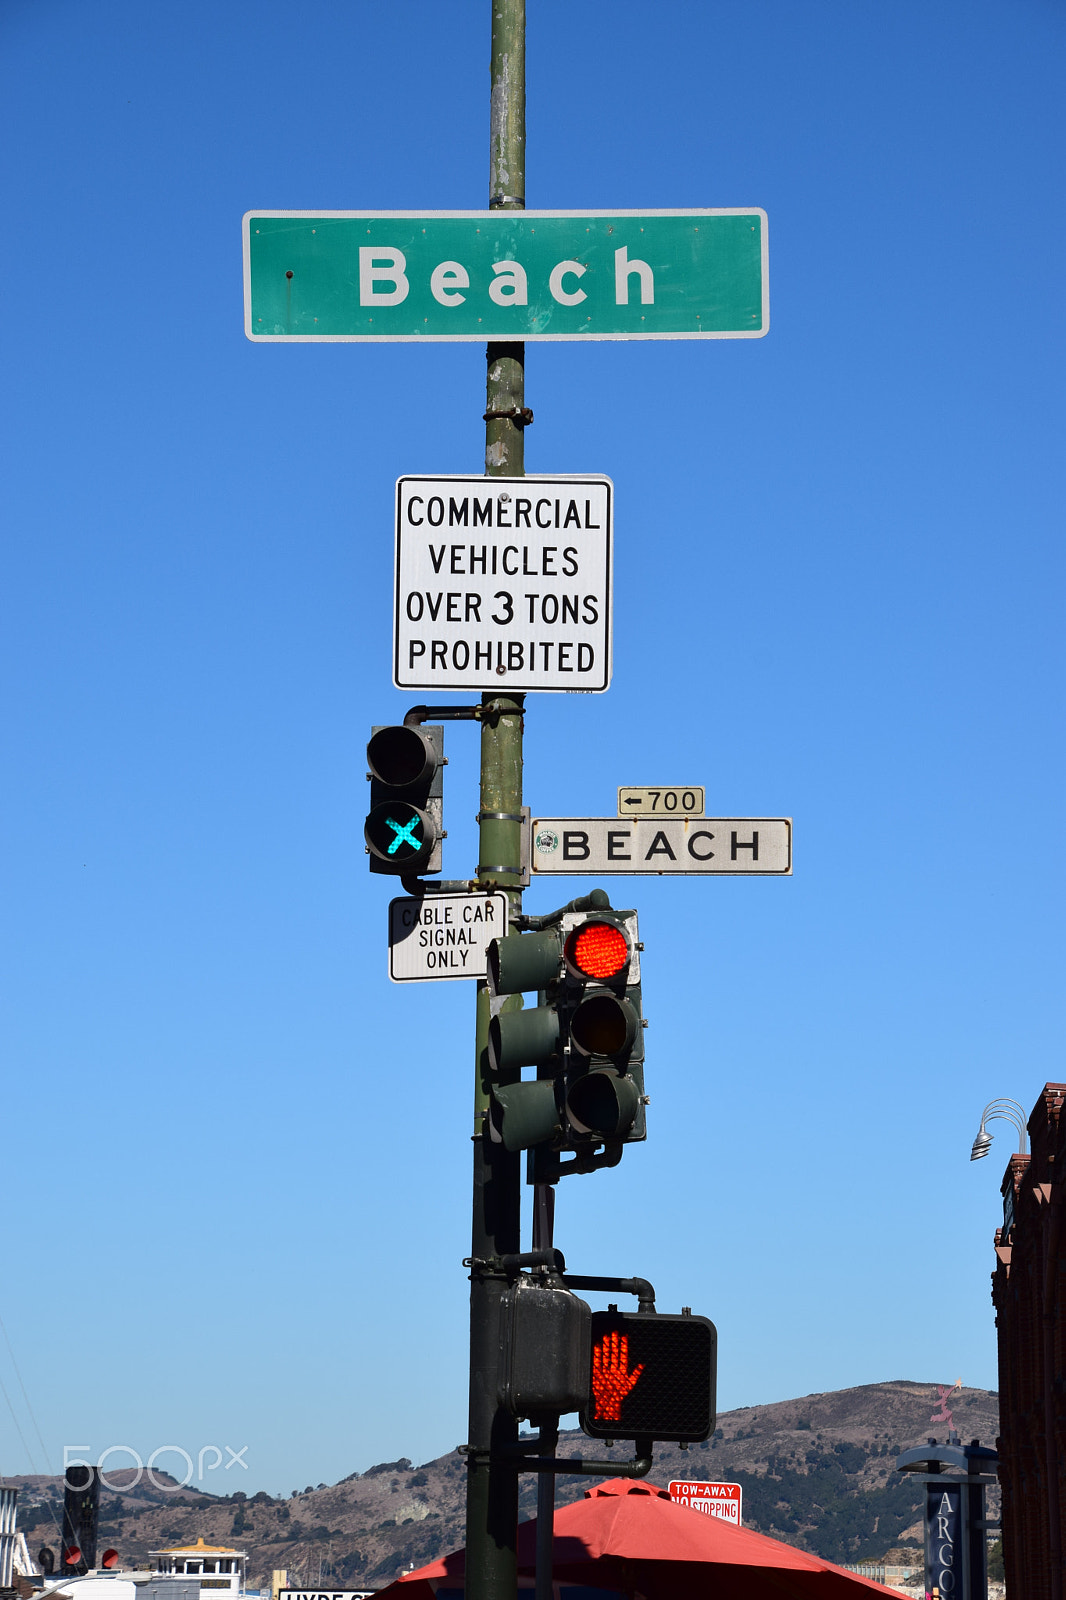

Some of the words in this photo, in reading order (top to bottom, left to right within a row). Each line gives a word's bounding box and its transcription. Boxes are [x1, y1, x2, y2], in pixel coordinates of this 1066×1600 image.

[359, 246, 655, 307] Beach
[408, 496, 600, 529] COMMERCIAL
[429, 545, 578, 576] VEHICLES
[407, 592, 481, 622] OVER
[492, 591, 513, 625] 3
[525, 594, 598, 624] TONS
[409, 640, 594, 672] PROHIBITED
[648, 792, 695, 810] 700
[563, 831, 759, 861] BEACH
[402, 906, 453, 926] CABLE
[463, 905, 494, 922] CAR
[419, 927, 477, 947] SIGNAL
[427, 949, 469, 969] ONLY
[676, 1485, 734, 1497] TOW-AWAY
[937, 1492, 955, 1600] ARGO
